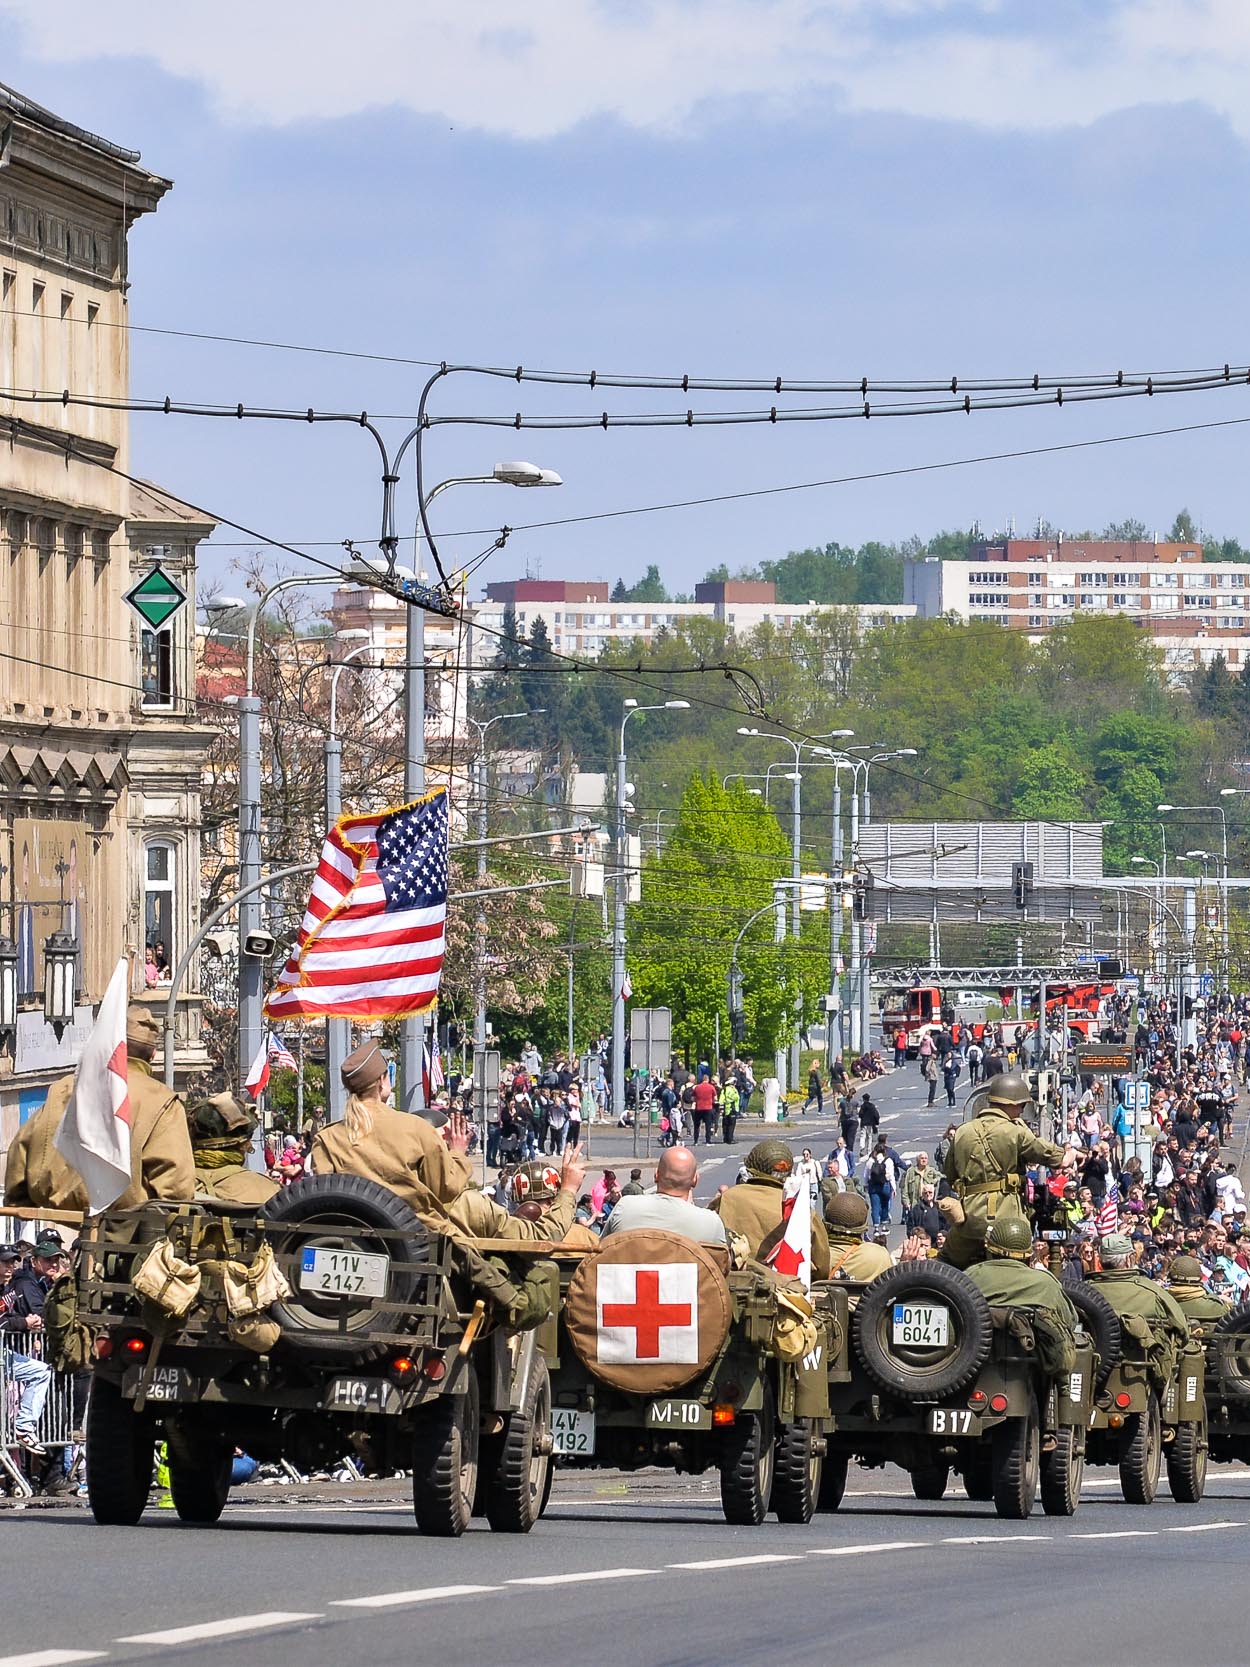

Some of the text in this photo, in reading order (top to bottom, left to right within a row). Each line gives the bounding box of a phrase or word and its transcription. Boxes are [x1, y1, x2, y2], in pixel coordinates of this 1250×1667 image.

[330, 1254, 360, 1272] 11V
[321, 1273, 364, 1292] 2147
[903, 1309, 933, 1325] 01V
[903, 1327, 941, 1343] 6041
[138, 1366, 179, 1383] 11AB
[334, 1380, 388, 1408] HQ-1
[651, 1402, 700, 1424] M-10
